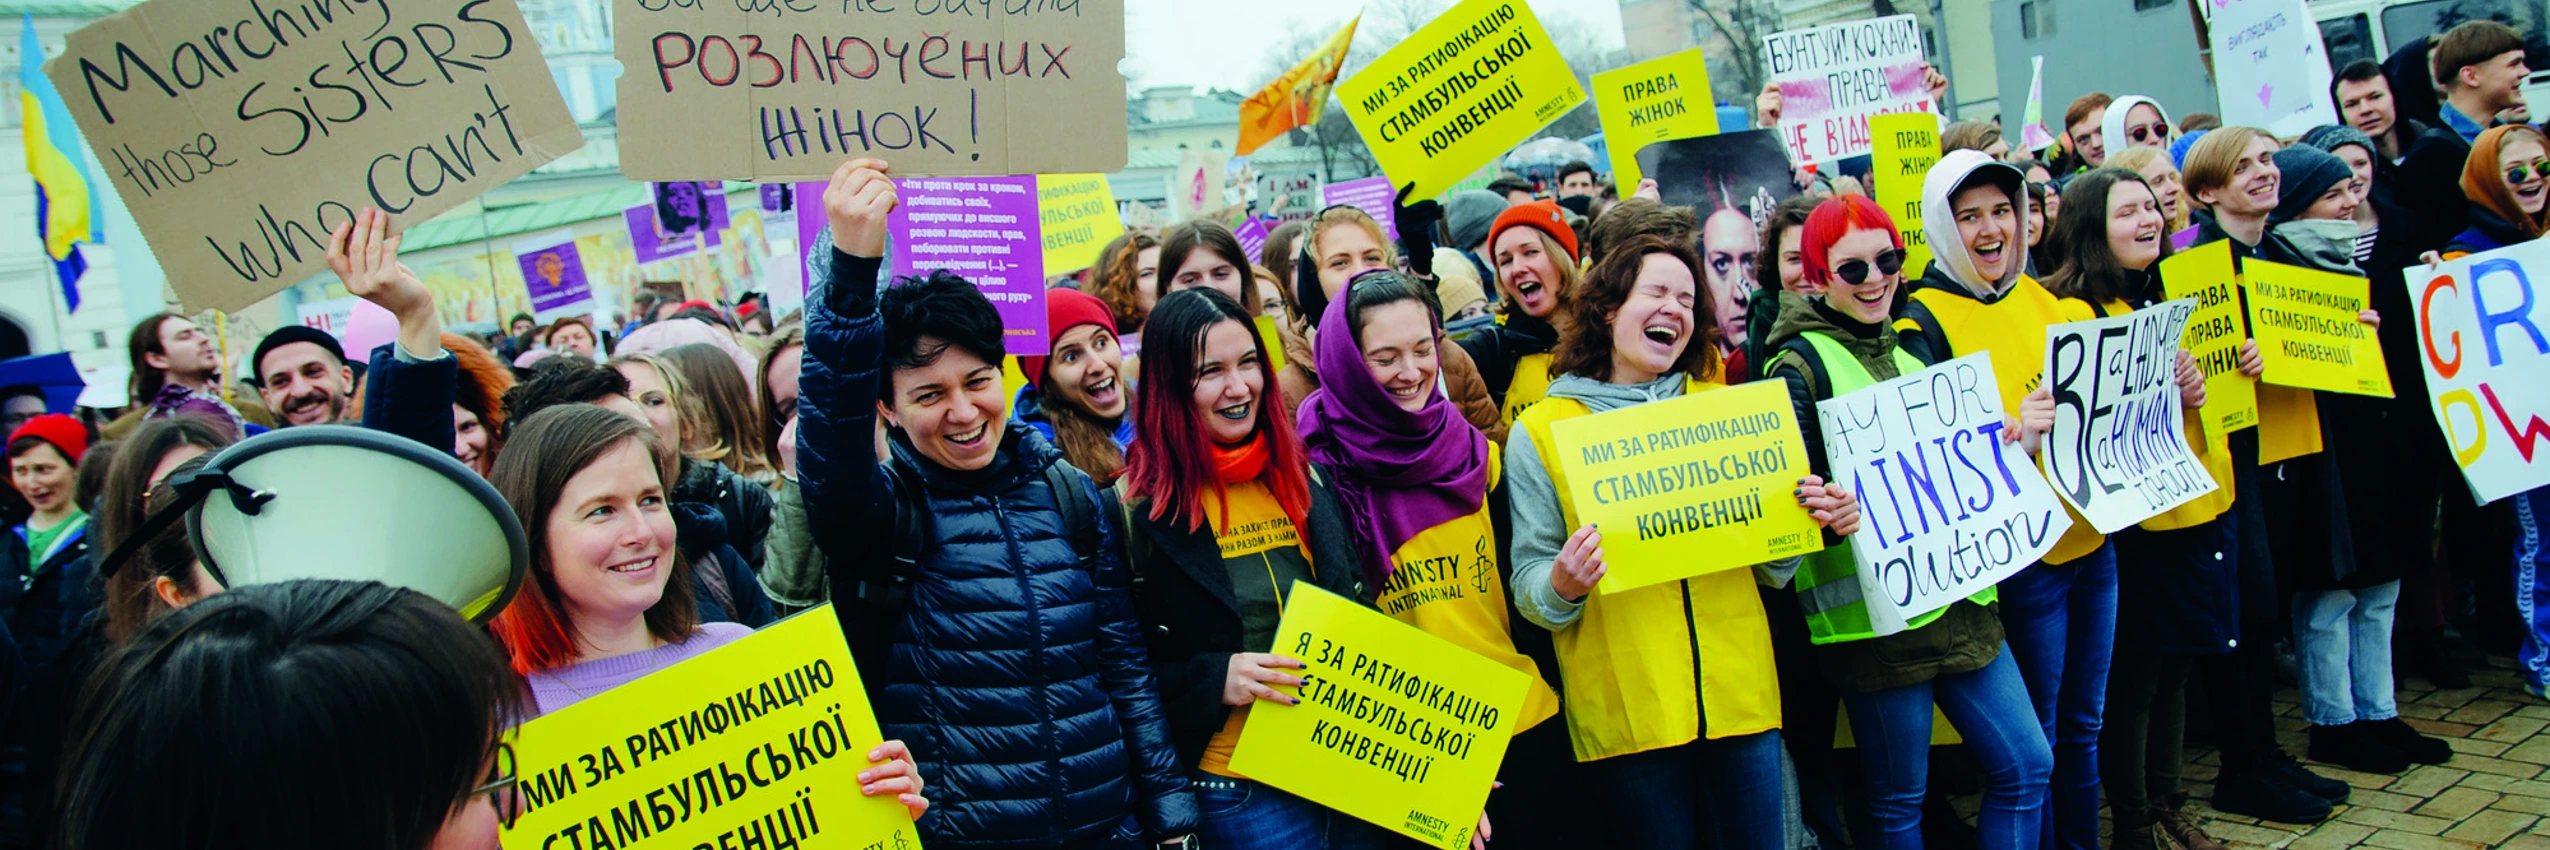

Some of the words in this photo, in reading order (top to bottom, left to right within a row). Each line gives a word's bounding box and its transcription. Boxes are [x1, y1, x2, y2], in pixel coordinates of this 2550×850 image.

[1362, 88, 1390, 116] МИ
[1387, 75, 1411, 98] ЗА
[1407, 3, 1516, 83] РАТИФІКАЦІЮ
[1768, 27, 1849, 74] БУНТУЙ!
[1852, 19, 1918, 62] КОХАЙ!
[1379, 26, 1532, 143] СТАМБУЛЬСЬКОЇ
[1623, 73, 1679, 102] ПРАВА
[1828, 67, 1893, 110] ПРАВА
[1420, 75, 1525, 159] КОНВЕНЦІЇ
[1628, 96, 1686, 128] ЖІНОК
[112, 132, 238, 197] those
[367, 84, 522, 214] can't
[1784, 123, 1812, 161] НЕ
[923, 181, 951, 192] проти
[953, 182, 976, 192] крок
[965, 214, 977, 223] до
[2255, 281, 2272, 297] МИ
[2275, 284, 2288, 300] ЗА
[2290, 287, 2361, 313] РАТИФІКАЦІЮ
[2191, 315, 2235, 347] ПРАВА
[2282, 339, 2354, 367] КОНВЕНЦІЇ
[1898, 364, 1993, 436] FOR
[1581, 442, 1615, 466] МИ
[1618, 437, 1645, 459] ЗА
[1647, 410, 1781, 453] РАТИФІКАЦІЮ
[1593, 440, 1788, 505] СТАМБУЛЬСЬКОЇ
[1636, 487, 1763, 541] КОНВЕНЦІЇ
[1767, 533, 1801, 548] AMNESTY
[1237, 536, 1266, 550] РАЗОМ
[1295, 632, 1312, 656] Я
[1316, 639, 1345, 671] ЗА
[1351, 653, 1499, 730] РАТИФІКАЦІЮ
[520, 762, 577, 813] МИ
[578, 745, 625, 788] ЗА
[625, 658, 835, 769] РАТИФІКАЦІЮ
[1298, 674, 1476, 760] СТАМБУЛЬСЬКОЇ
[1311, 719, 1434, 783] КОНВЕНЦІЇ
[1407, 809, 1450, 833] AMNESTY
